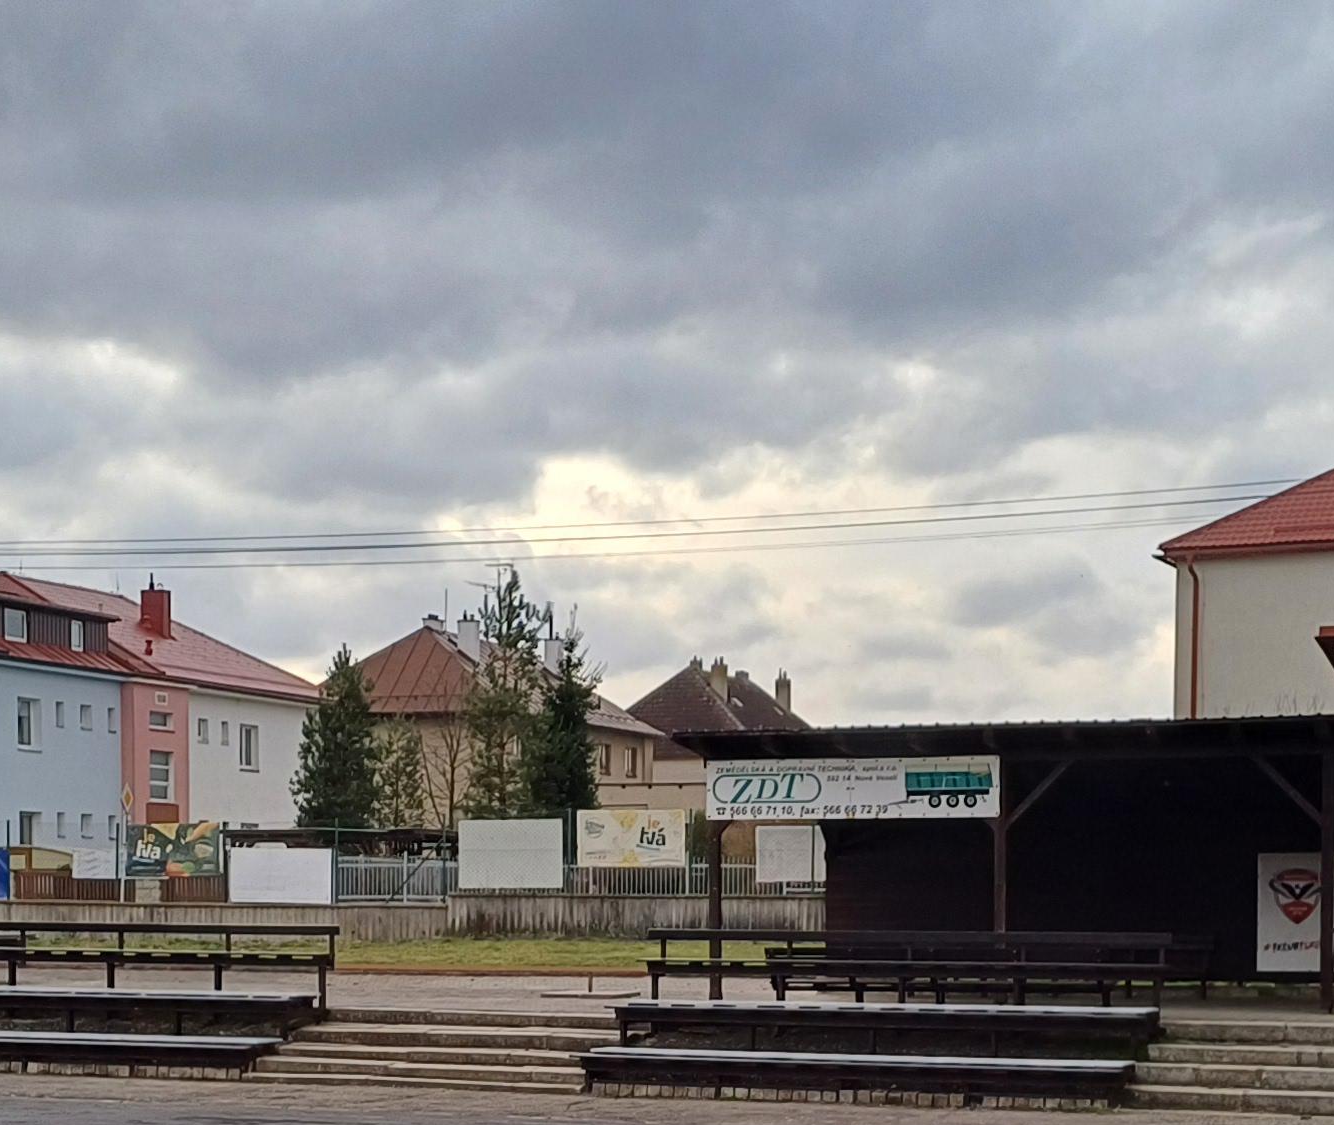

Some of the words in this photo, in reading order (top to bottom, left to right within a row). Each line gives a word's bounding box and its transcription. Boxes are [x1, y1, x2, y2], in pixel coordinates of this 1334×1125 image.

[730, 773, 804, 804] ZDT
[730, 806, 748, 816] 566
[823, 805, 842, 815] 566
[639, 826, 666, 846] tvá
